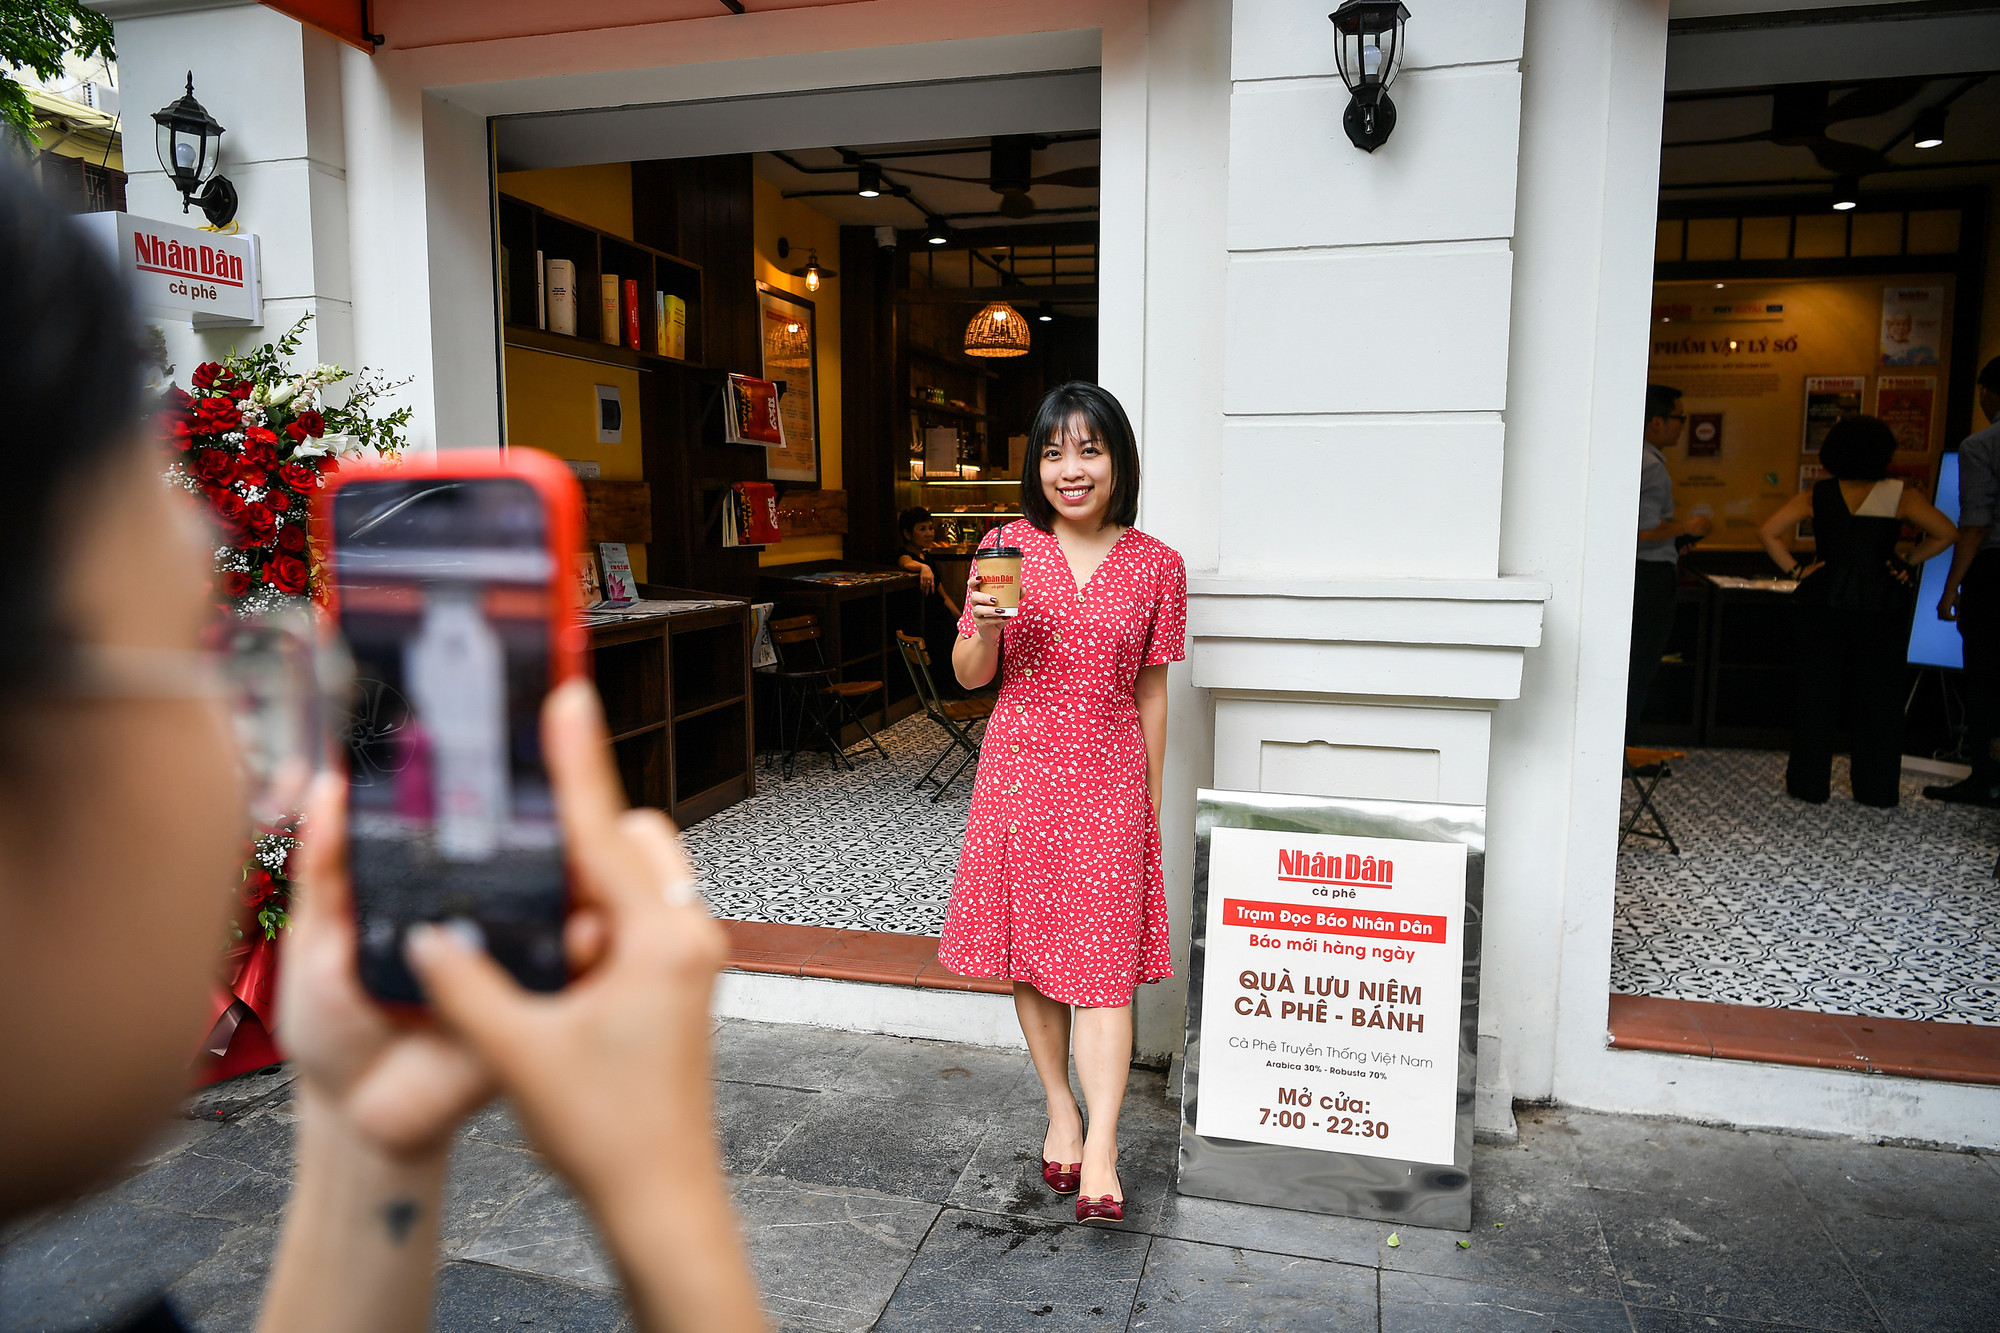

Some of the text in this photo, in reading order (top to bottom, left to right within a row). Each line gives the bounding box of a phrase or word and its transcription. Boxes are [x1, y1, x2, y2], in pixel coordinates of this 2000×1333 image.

[134, 231, 243, 281] Nhân Dân
[169, 280, 217, 300] cà phê
[983, 574, 1014, 583] Nhân Dân
[1278, 848, 1394, 883] Nhân Dân
[1312, 886, 1357, 900] cà phê
[1236, 905, 1433, 935] Trạm Đọc Báo Nhân Dân
[1249, 933, 1416, 964] Báo mới hàng ngày
[1239, 967, 1422, 1009] QUÀ LƯU NIỆM
[1234, 992, 1272, 1018] CÀ
[1281, 998, 1328, 1023] PHÊ
[1351, 1003, 1425, 1033] BÁNH
[1228, 1036, 1433, 1069] Cà Phê Truyền Thống Việt Nam
[1265, 1060, 1302, 1071] Arabica
[1304, 1063, 1323, 1073] 30%
[1329, 1066, 1366, 1078] Robusta
[1369, 1070, 1388, 1080] 70%
[1278, 1086, 1371, 1115] Mở cửa:
[1259, 1107, 1306, 1130] 7:00
[1326, 1115, 1390, 1139] 22:30
